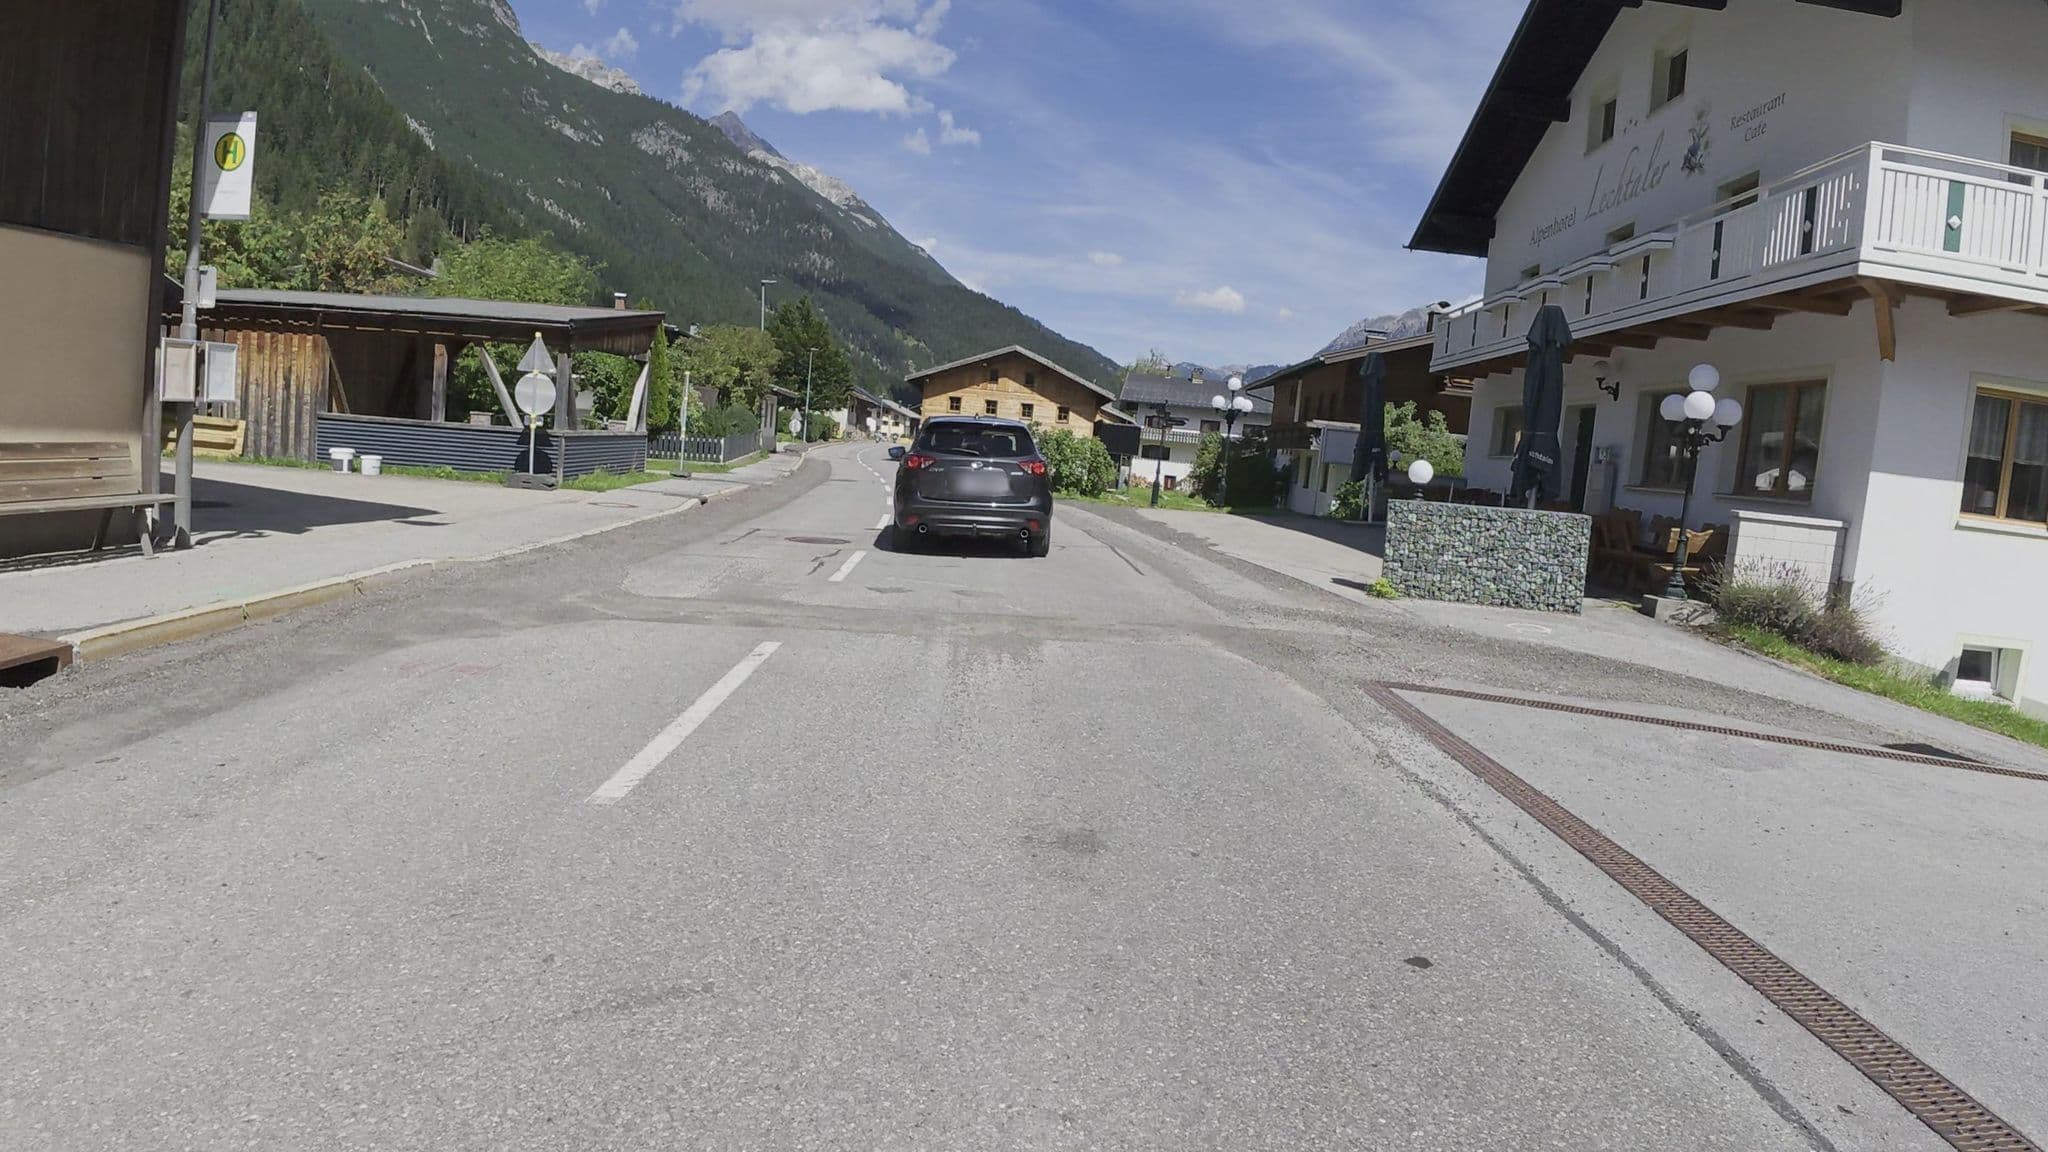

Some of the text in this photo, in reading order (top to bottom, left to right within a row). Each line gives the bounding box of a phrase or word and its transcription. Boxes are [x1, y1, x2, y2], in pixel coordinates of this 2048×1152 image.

[1730, 92, 1786, 130] Restaurant
[222, 140, 239, 164] H
[1529, 128, 1670, 248] Alpenhotel Lechtaler
